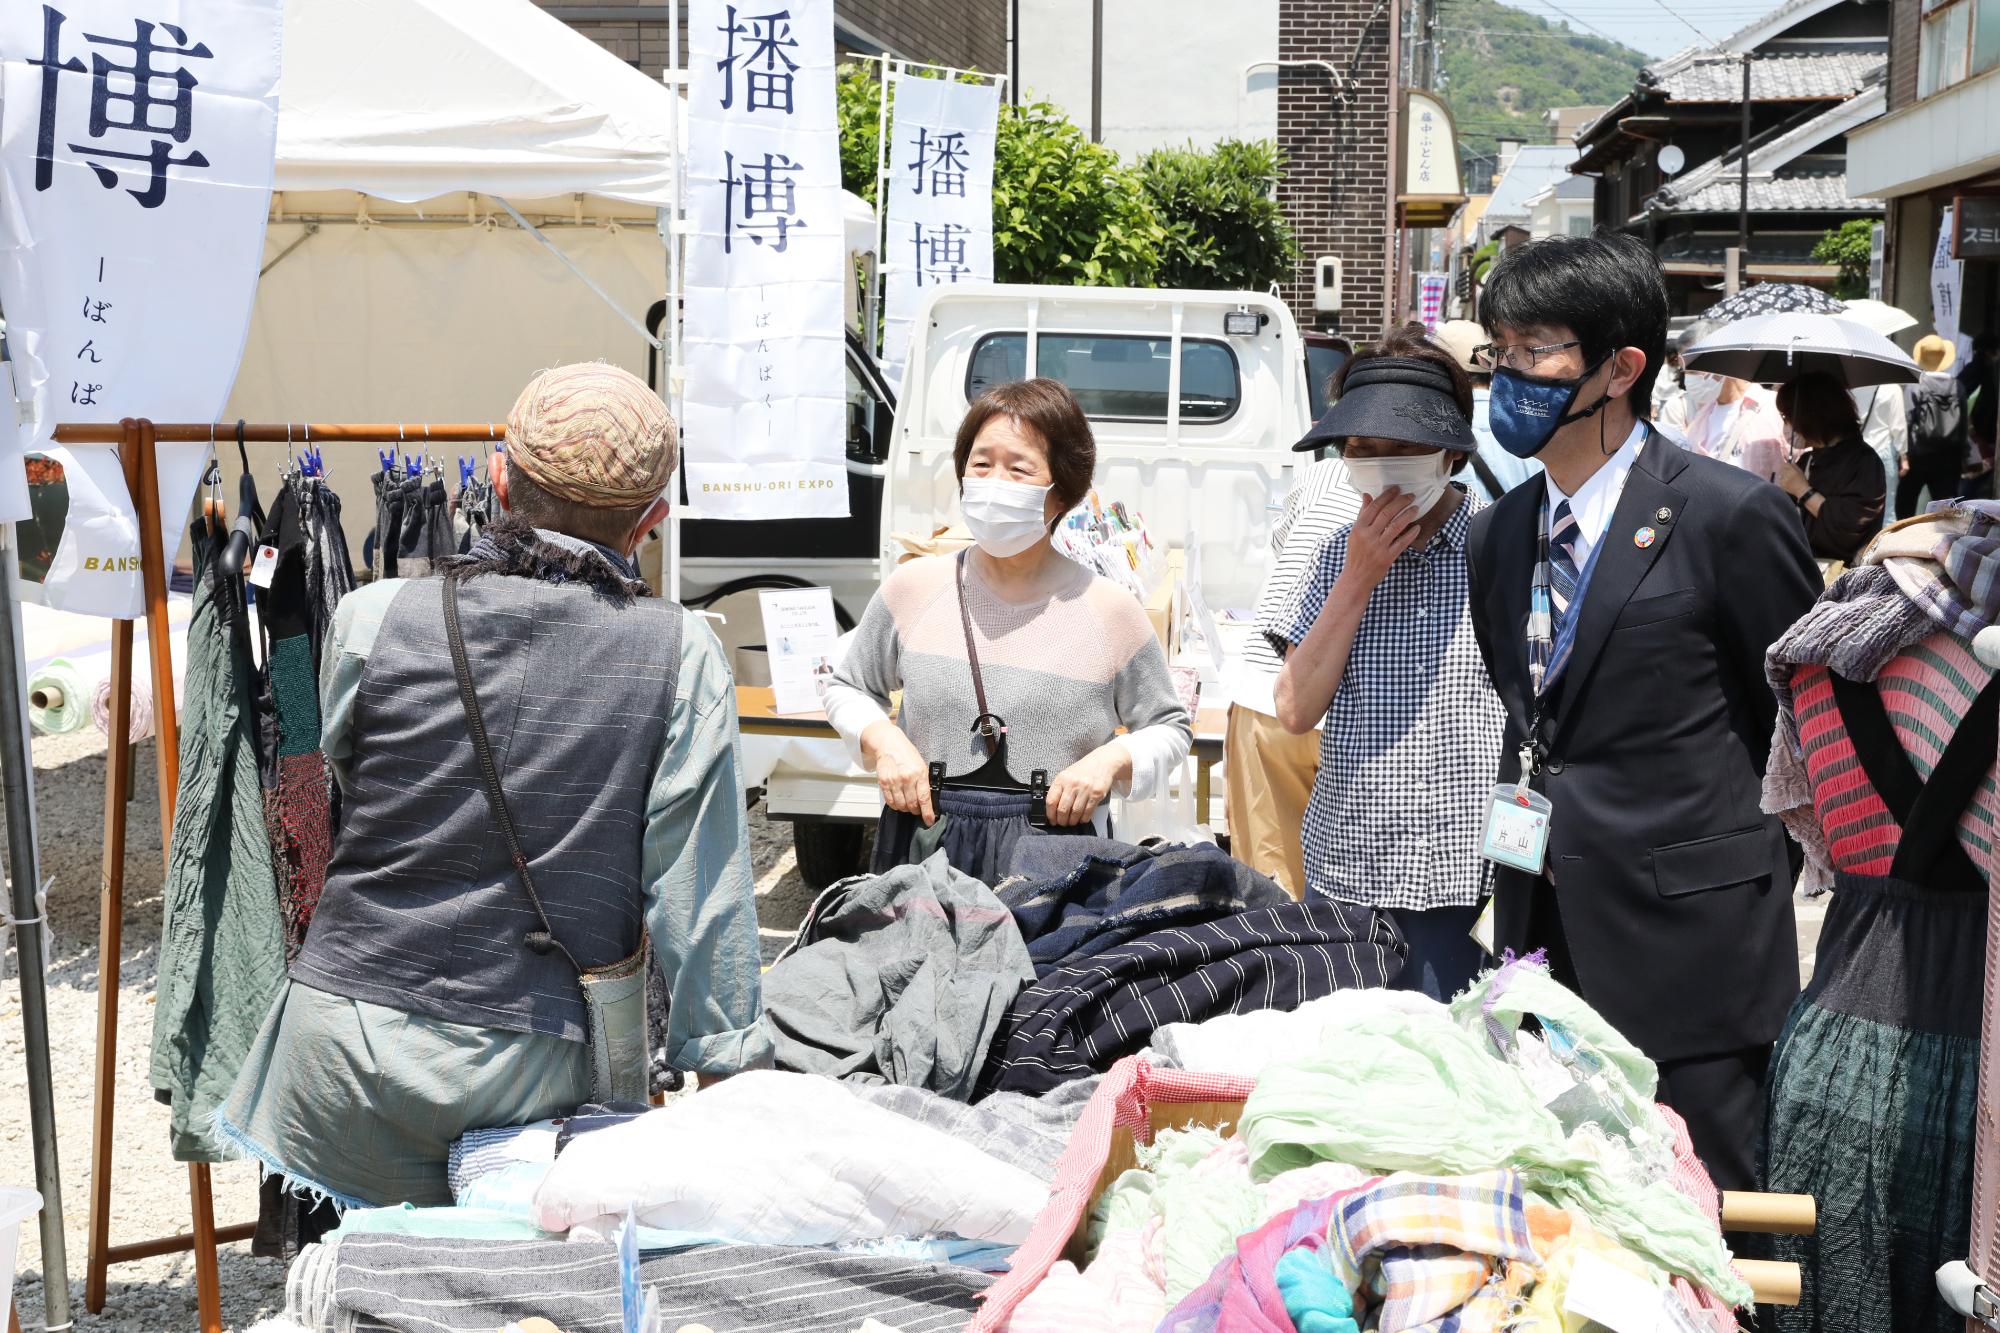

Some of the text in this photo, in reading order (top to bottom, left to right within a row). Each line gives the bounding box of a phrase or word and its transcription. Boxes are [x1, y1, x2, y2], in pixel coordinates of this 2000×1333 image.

[26, 4, 214, 208] 博
[703, 480, 834, 492] BANSHU-ORI EXPO
